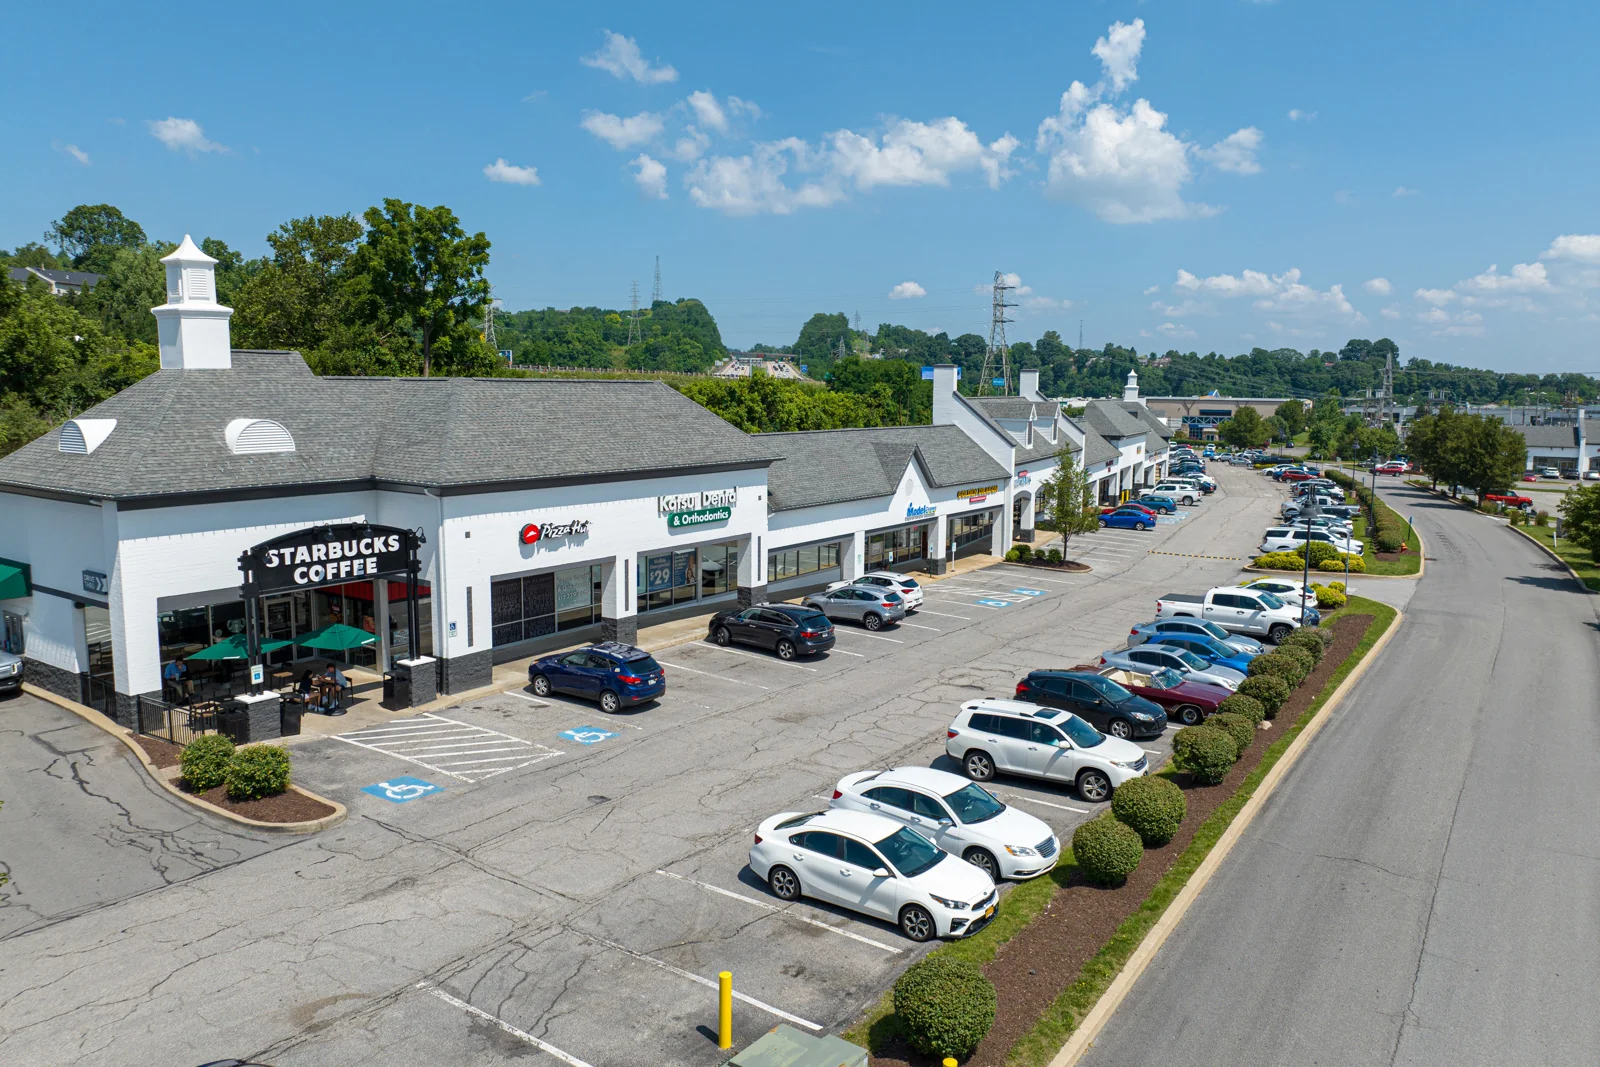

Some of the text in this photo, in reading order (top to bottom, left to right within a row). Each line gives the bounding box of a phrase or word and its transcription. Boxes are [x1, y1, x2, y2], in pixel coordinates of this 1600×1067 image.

[659, 494, 697, 511] Katsu
[674, 509, 729, 526] & Orthodontics
[541, 520, 589, 540] Pizza Hut
[265, 534, 400, 568] STARBUCKS
[293, 556, 378, 585] COFFEE
[650, 568, 670, 585] $29
